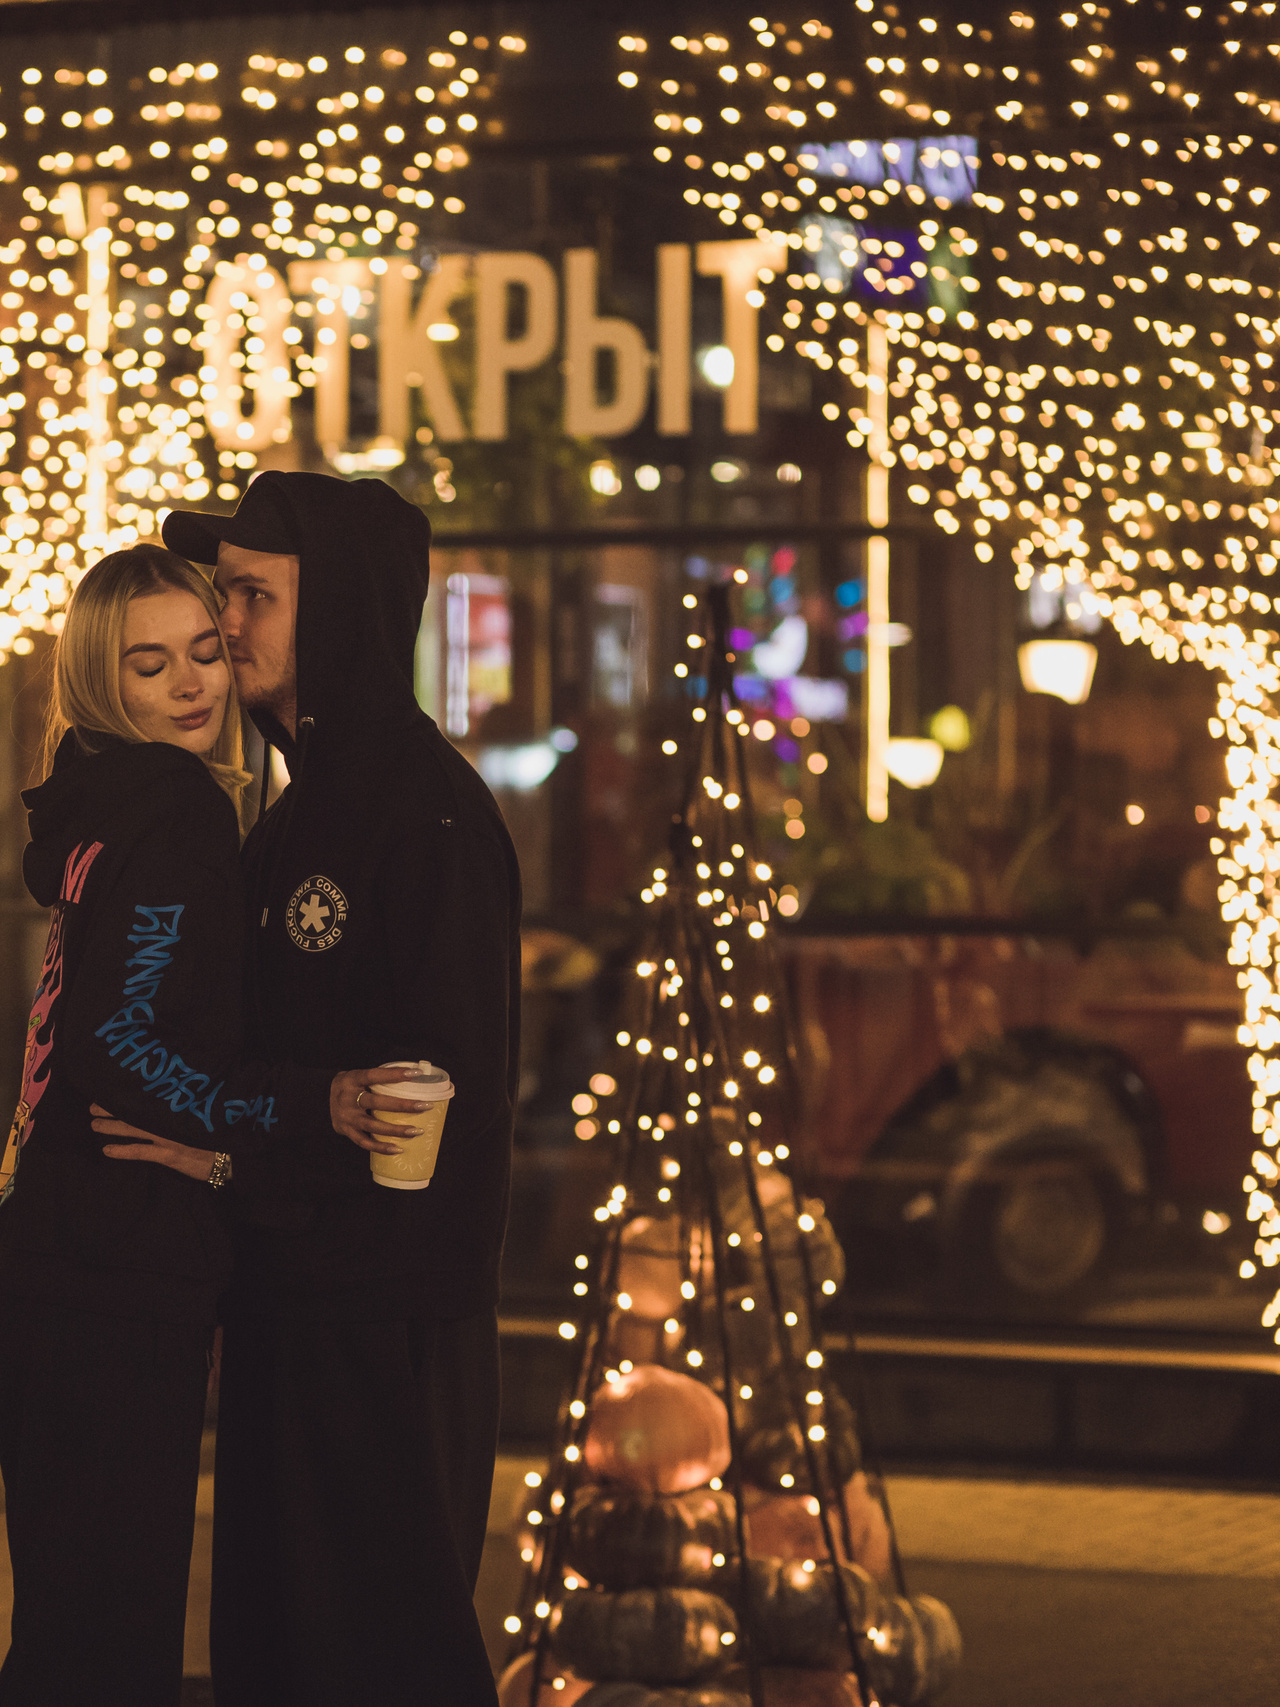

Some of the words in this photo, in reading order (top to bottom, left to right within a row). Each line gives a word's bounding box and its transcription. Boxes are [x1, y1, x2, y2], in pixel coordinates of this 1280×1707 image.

[204, 237, 788, 449] ОТКРЫТ
[287, 880, 311, 948] FUCKDOWN
[316, 878, 347, 921] COMME
[316, 927, 342, 948] DES
[223, 1095, 279, 1132] the
